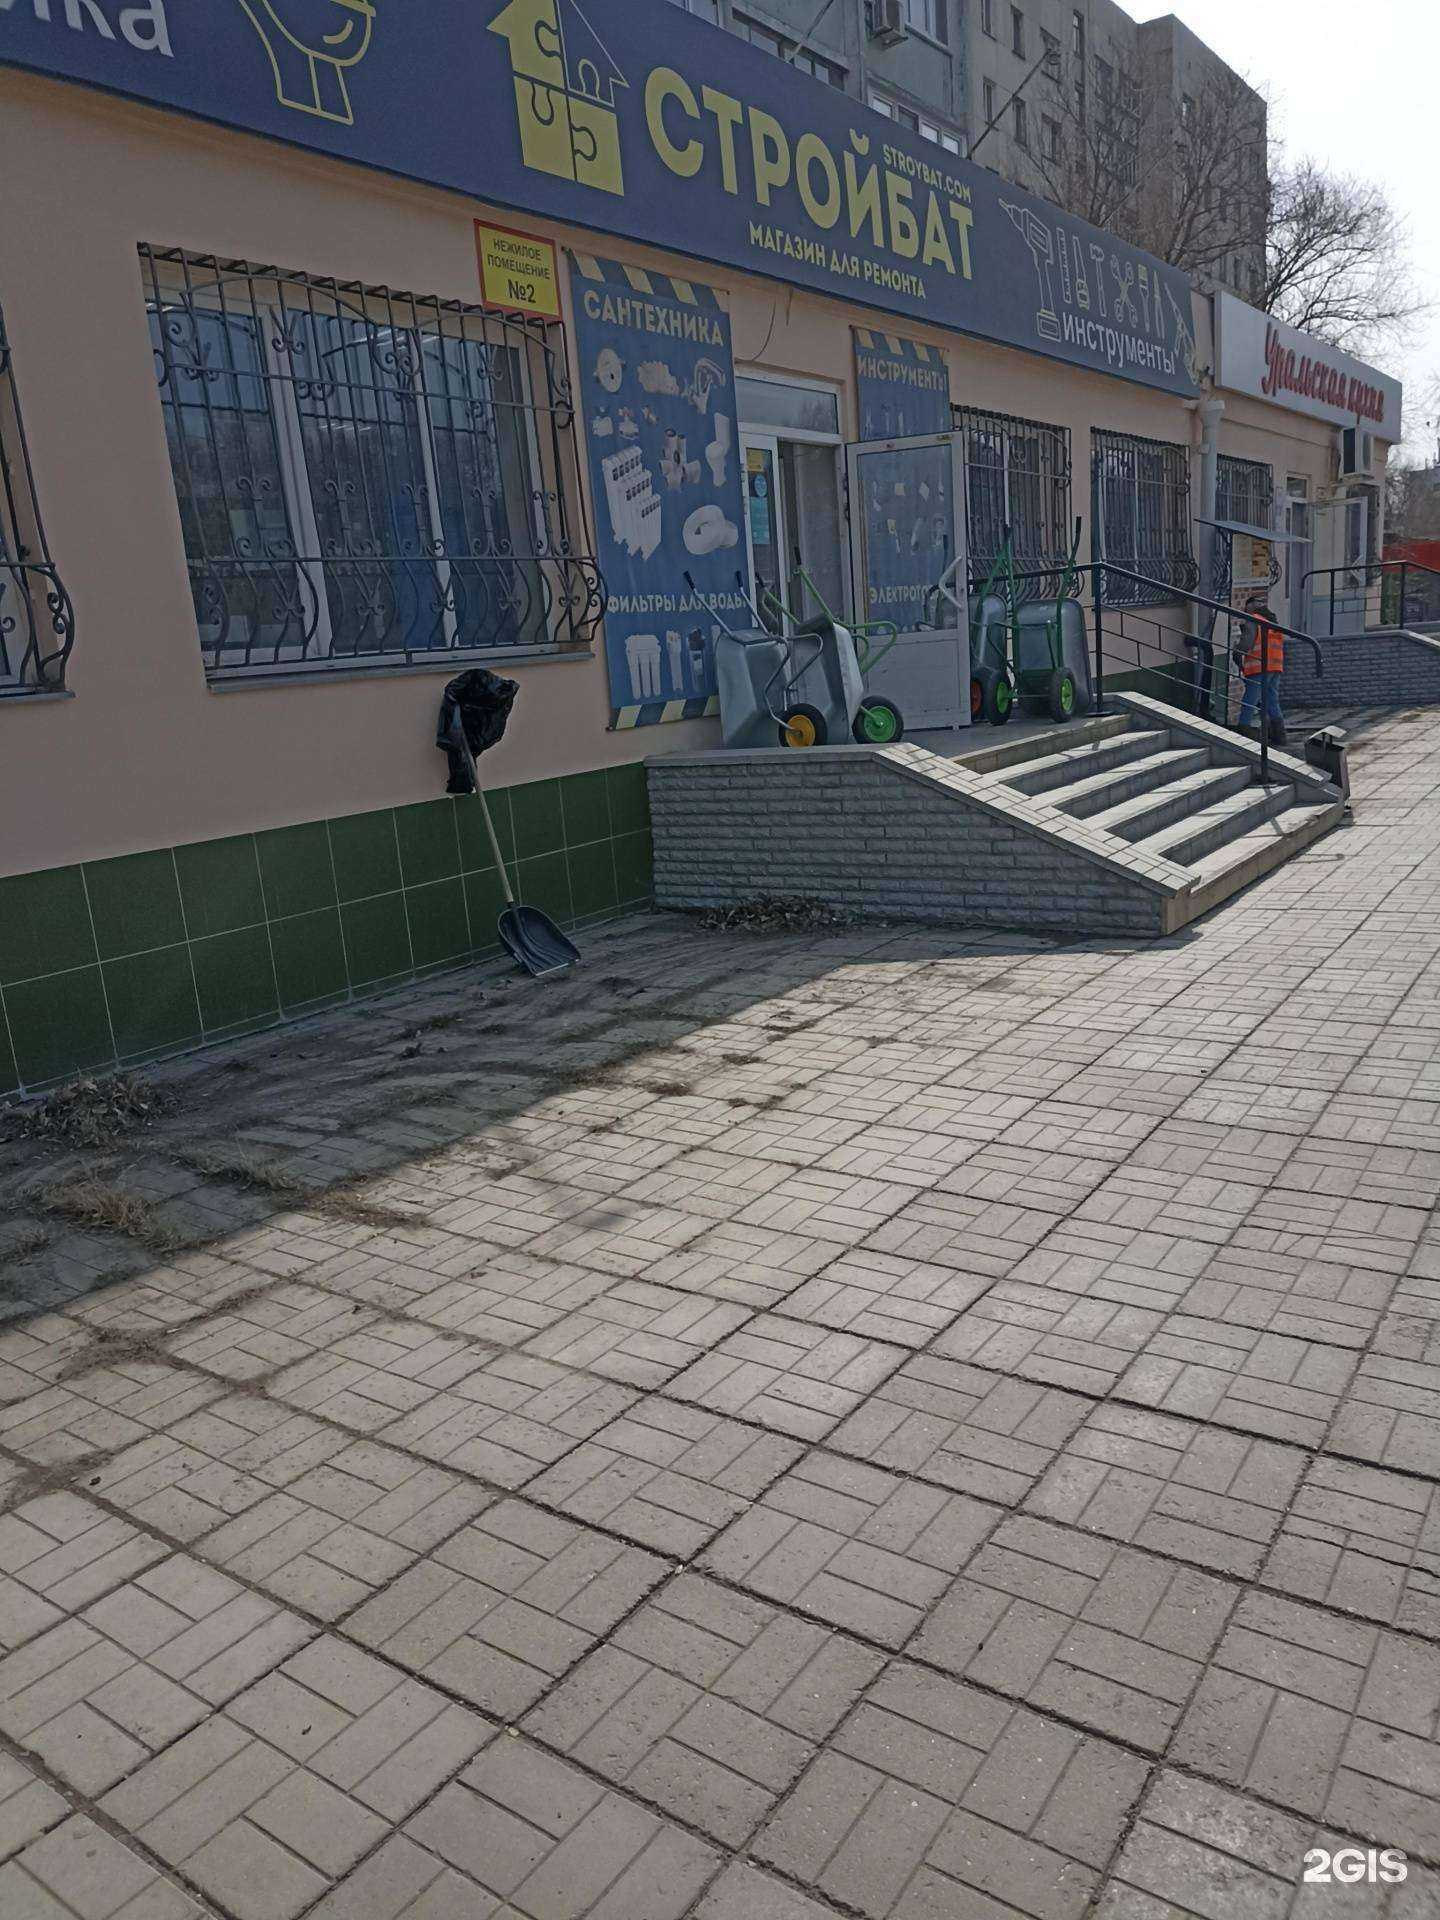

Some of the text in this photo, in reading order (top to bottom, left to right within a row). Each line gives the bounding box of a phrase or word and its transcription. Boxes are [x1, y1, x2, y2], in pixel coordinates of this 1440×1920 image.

[645, 67, 974, 280] СТРОЙБАТ
[883, 144, 972, 203] STROYBAT.COM
[486, 254, 551, 280] ПОМЕЩЕНИЕ
[493, 239, 542, 261] НЕЖИЛОЕ
[749, 220, 926, 299] МАГАЗИН ДЛЯ РЕМОНТА
[507, 279, 537, 303] №2
[584, 289, 725, 347] САНТЕХНИКА
[857, 355, 948, 392] ИНСТРУМЕНТЫ
[606, 593, 676, 614] ФИЛЬТРЫ
[679, 592, 706, 612] ДЛЯ
